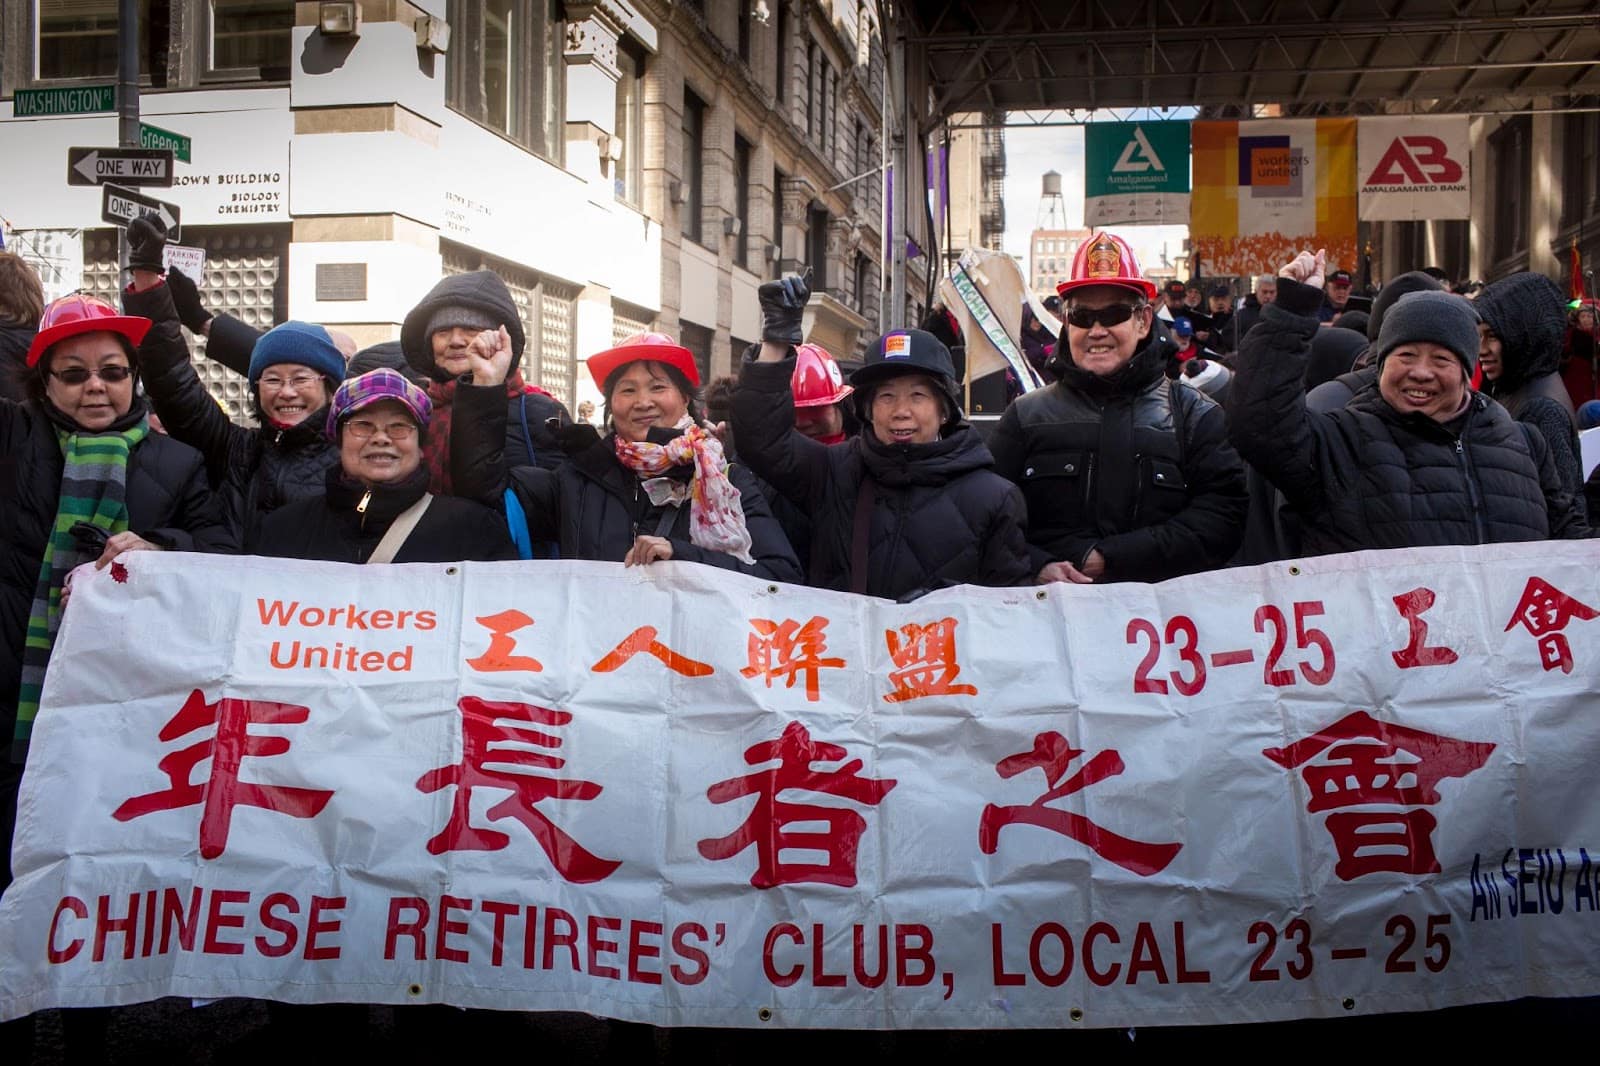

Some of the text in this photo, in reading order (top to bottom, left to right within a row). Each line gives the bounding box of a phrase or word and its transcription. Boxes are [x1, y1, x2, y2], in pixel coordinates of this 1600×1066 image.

[16, 88, 102, 114] WASHINGTON
[140, 126, 179, 159] Greene
[96, 160, 161, 175] ONE WAY
[1258, 153, 1310, 166] workers
[1258, 165, 1299, 177] united
[173, 173, 280, 186] ROWN BUILDING
[1107, 173, 1168, 185] Amalgamated
[1362, 184, 1467, 193] AMALGAMATED BANK
[111, 198, 133, 217] ONE
[218, 204, 280, 214] CHEMISTRY
[232, 192, 280, 202] BIOLOGY
[257, 598, 437, 631] Workers
[1392, 576, 1600, 675] 工會
[270, 641, 413, 672] United
[467, 609, 977, 703] 工人聯盟
[1127, 601, 1336, 697] 23-25
[113, 688, 1496, 884] 年長者之會
[1502, 847, 1567, 917] SEIU
[47, 886, 347, 964] CHINESE
[764, 923, 954, 1000] CLUB,
[991, 922, 1211, 987] LOCAL
